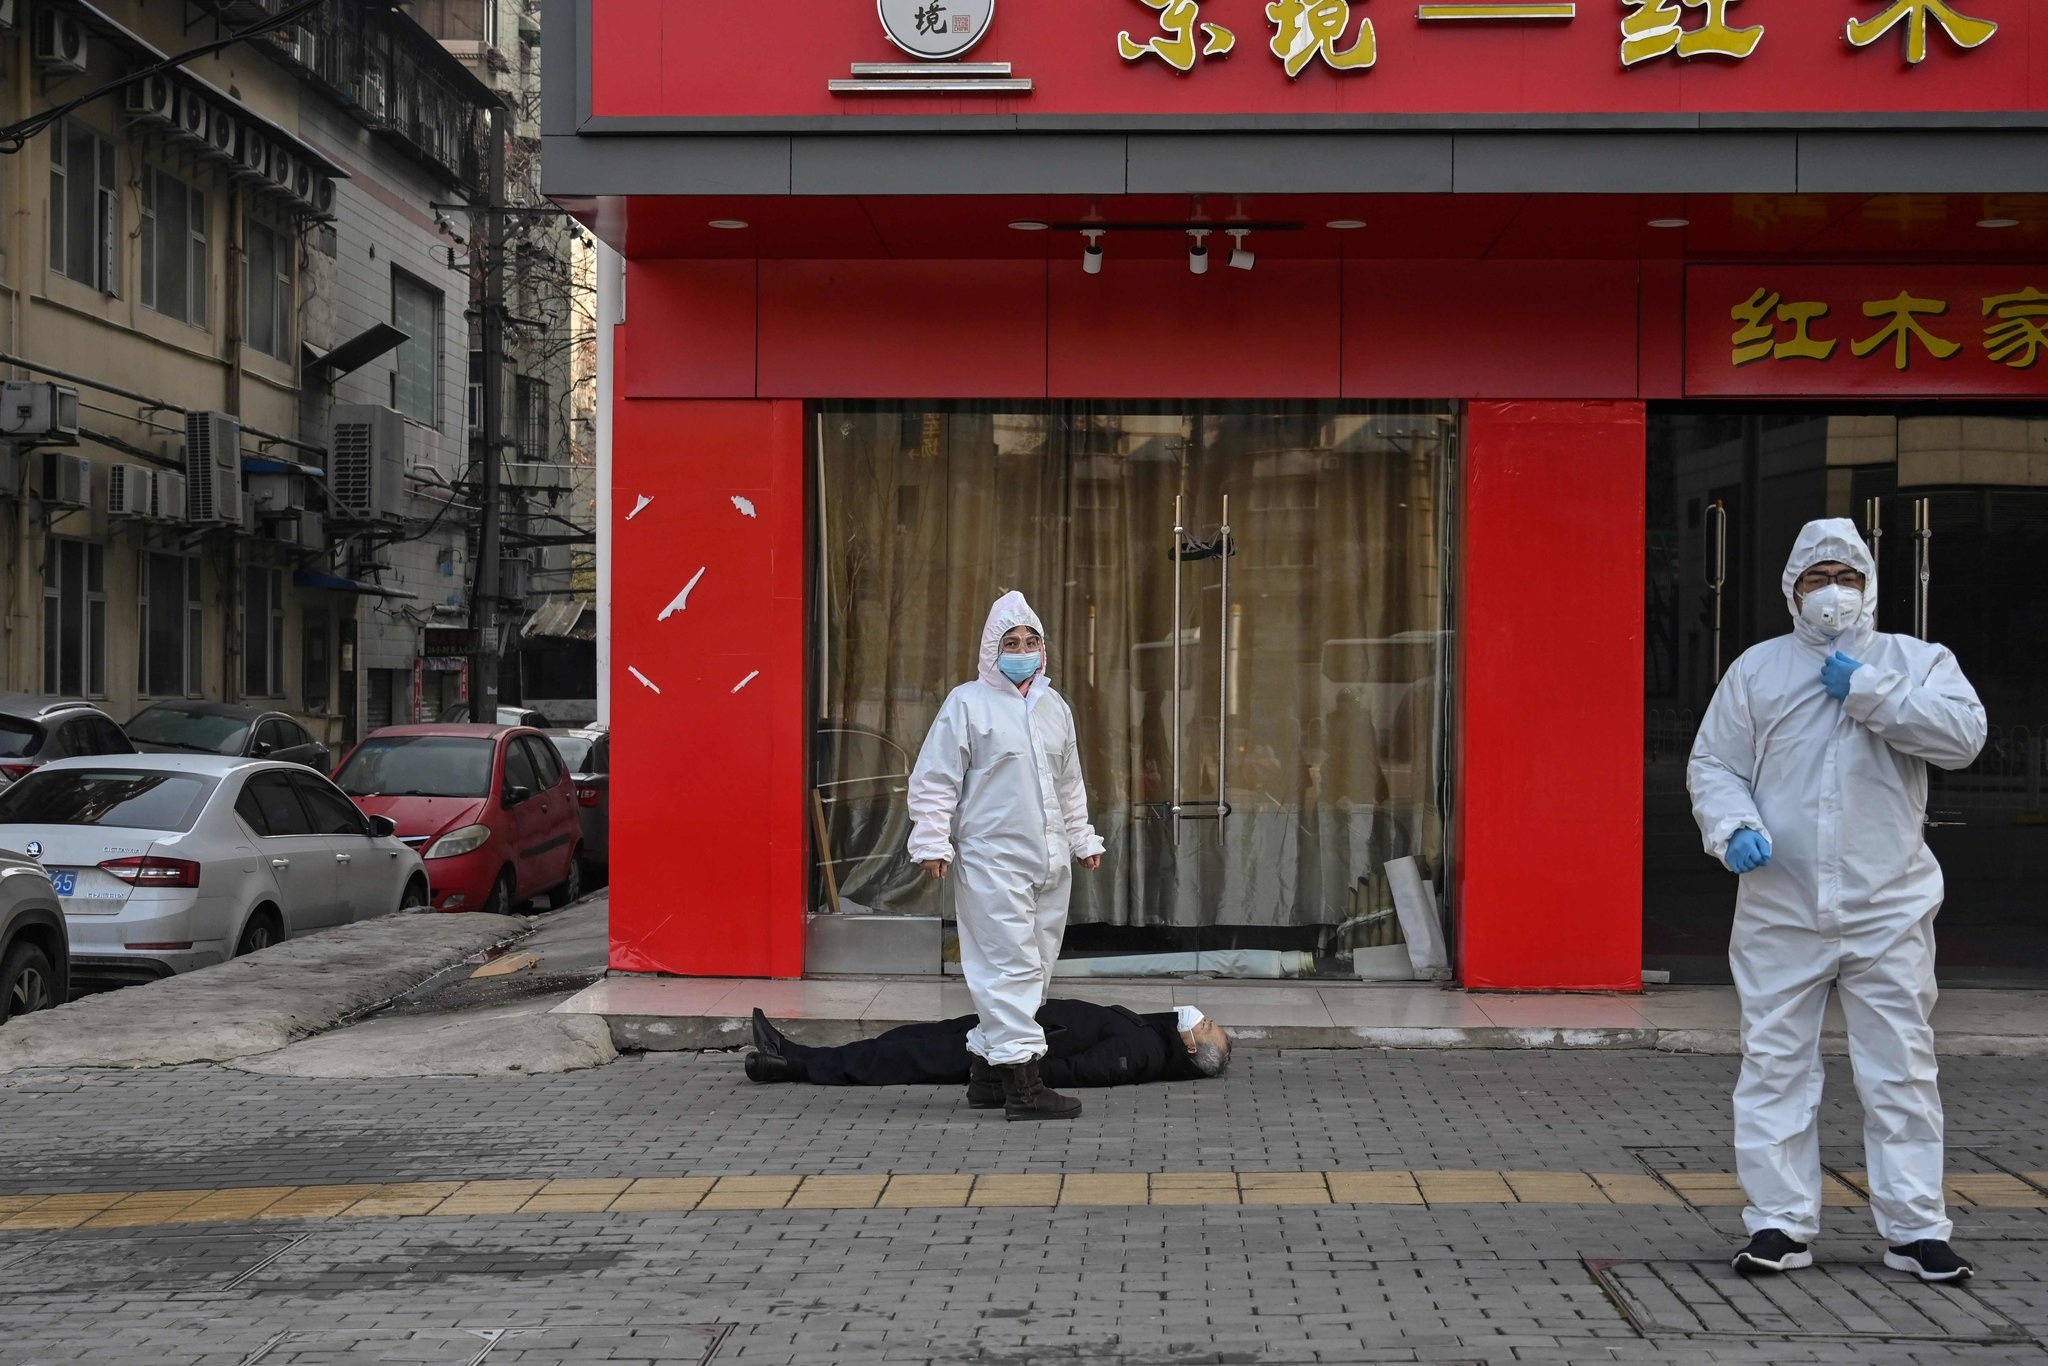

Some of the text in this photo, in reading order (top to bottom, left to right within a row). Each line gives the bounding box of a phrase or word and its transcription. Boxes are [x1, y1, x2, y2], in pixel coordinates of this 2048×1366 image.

[1730, 286, 2048, 370] 红木家
[48, 873, 74, 891] 65
